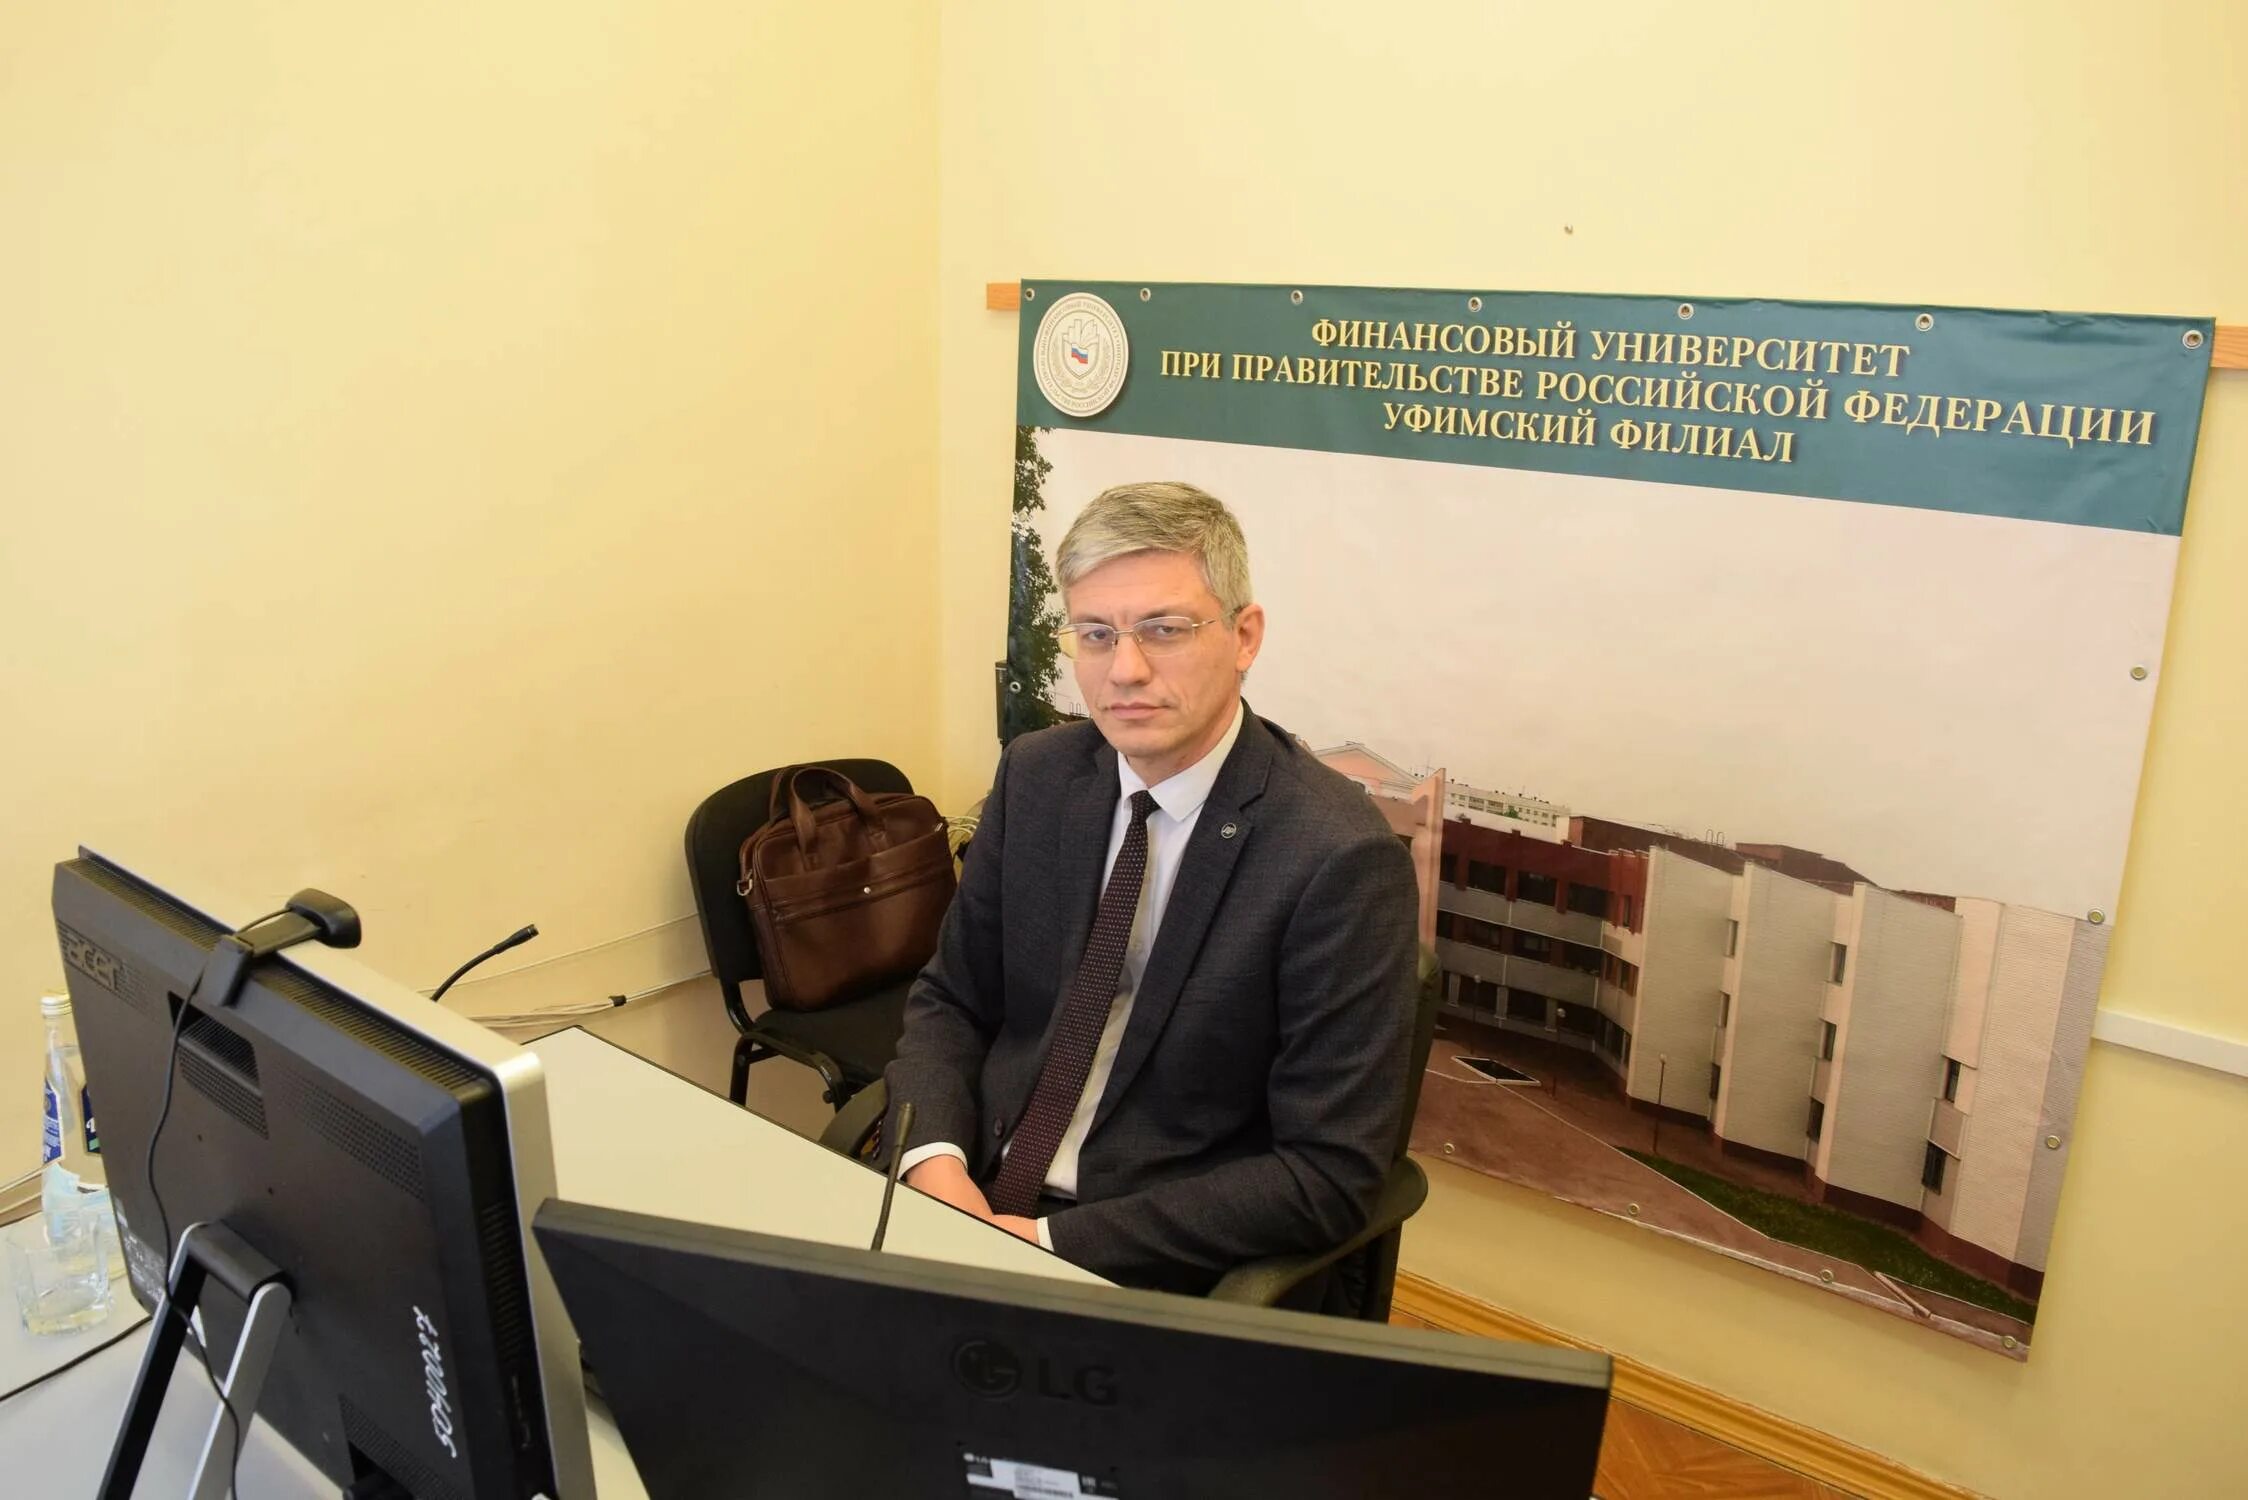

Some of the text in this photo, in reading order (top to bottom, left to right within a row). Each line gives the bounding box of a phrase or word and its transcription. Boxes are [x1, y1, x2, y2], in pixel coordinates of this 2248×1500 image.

[1311, 319, 1910, 377] ФИНАНСОВЫЙ УНИВЕРСИТЕТ
[1160, 350, 1221, 379] ПРИ
[1231, 353, 1523, 399] ПРАВИТЕЛЬСТВЕ
[1536, 370, 1830, 420] РОССИЙСКОЙ
[1843, 389, 2156, 449] ФЕДЕРАЦИИ
[1384, 402, 1796, 463] УФИМСКИЙ ФИЛИАЛ
[1037, 1357, 1119, 1407] LG
